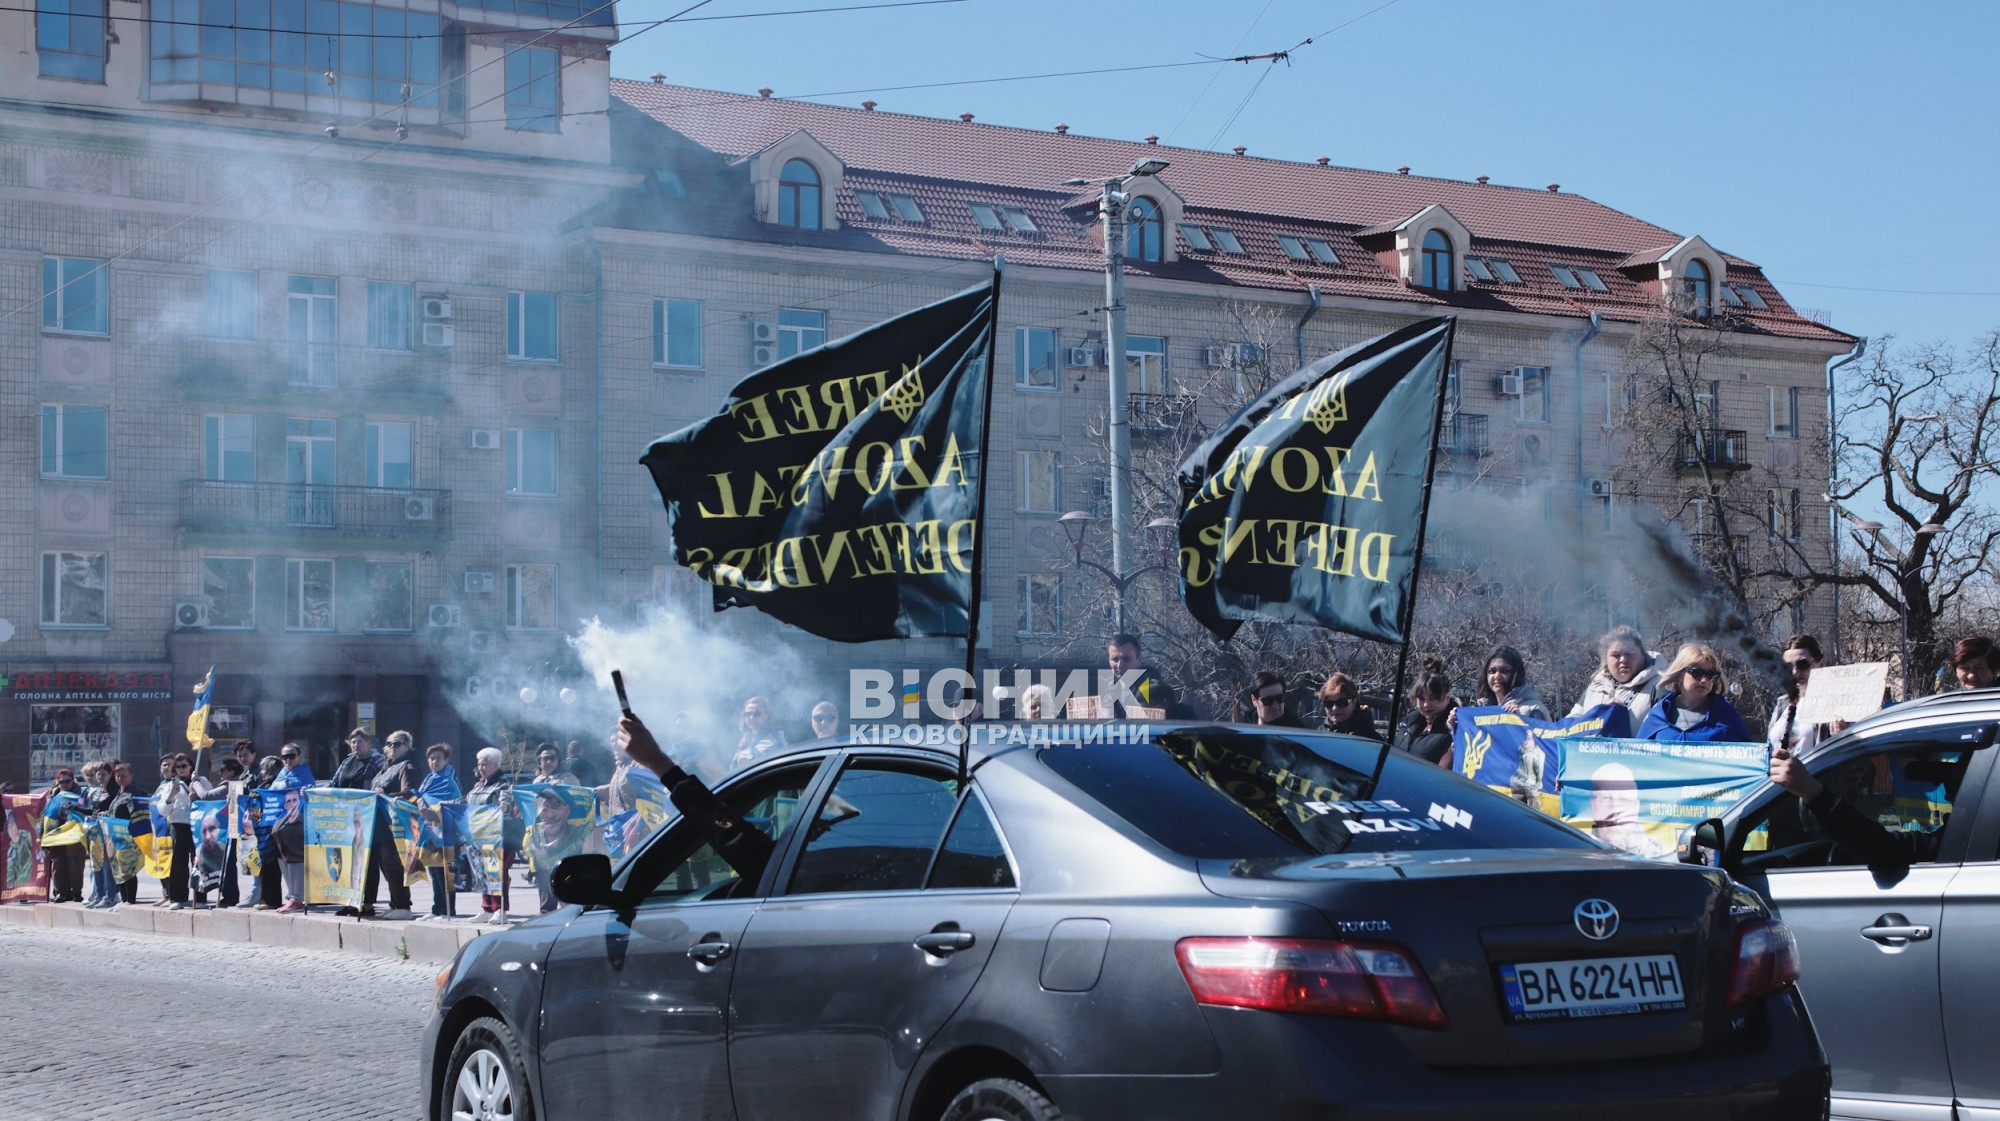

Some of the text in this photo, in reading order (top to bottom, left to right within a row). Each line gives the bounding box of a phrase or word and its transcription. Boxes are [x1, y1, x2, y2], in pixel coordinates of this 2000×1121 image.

[15, 672, 120, 689] АПТЕКА
[14, 692, 61, 700] ГОЛОВНА
[31, 733, 111, 747] ГОЛОВНА
[1578, 741, 1620, 755] БЕЗВІСТИ
[1671, 745, 1683, 757] НЕ
[1684, 745, 1726, 759] ЗНАЧИТЬ
[1304, 800, 1410, 815] FREE
[1650, 803, 1704, 818] ВОЛОДИМИР
[1342, 817, 1441, 834] AZOV
[1338, 920, 1391, 931] TOYOTA
[1570, 963, 1637, 1001] 6224
